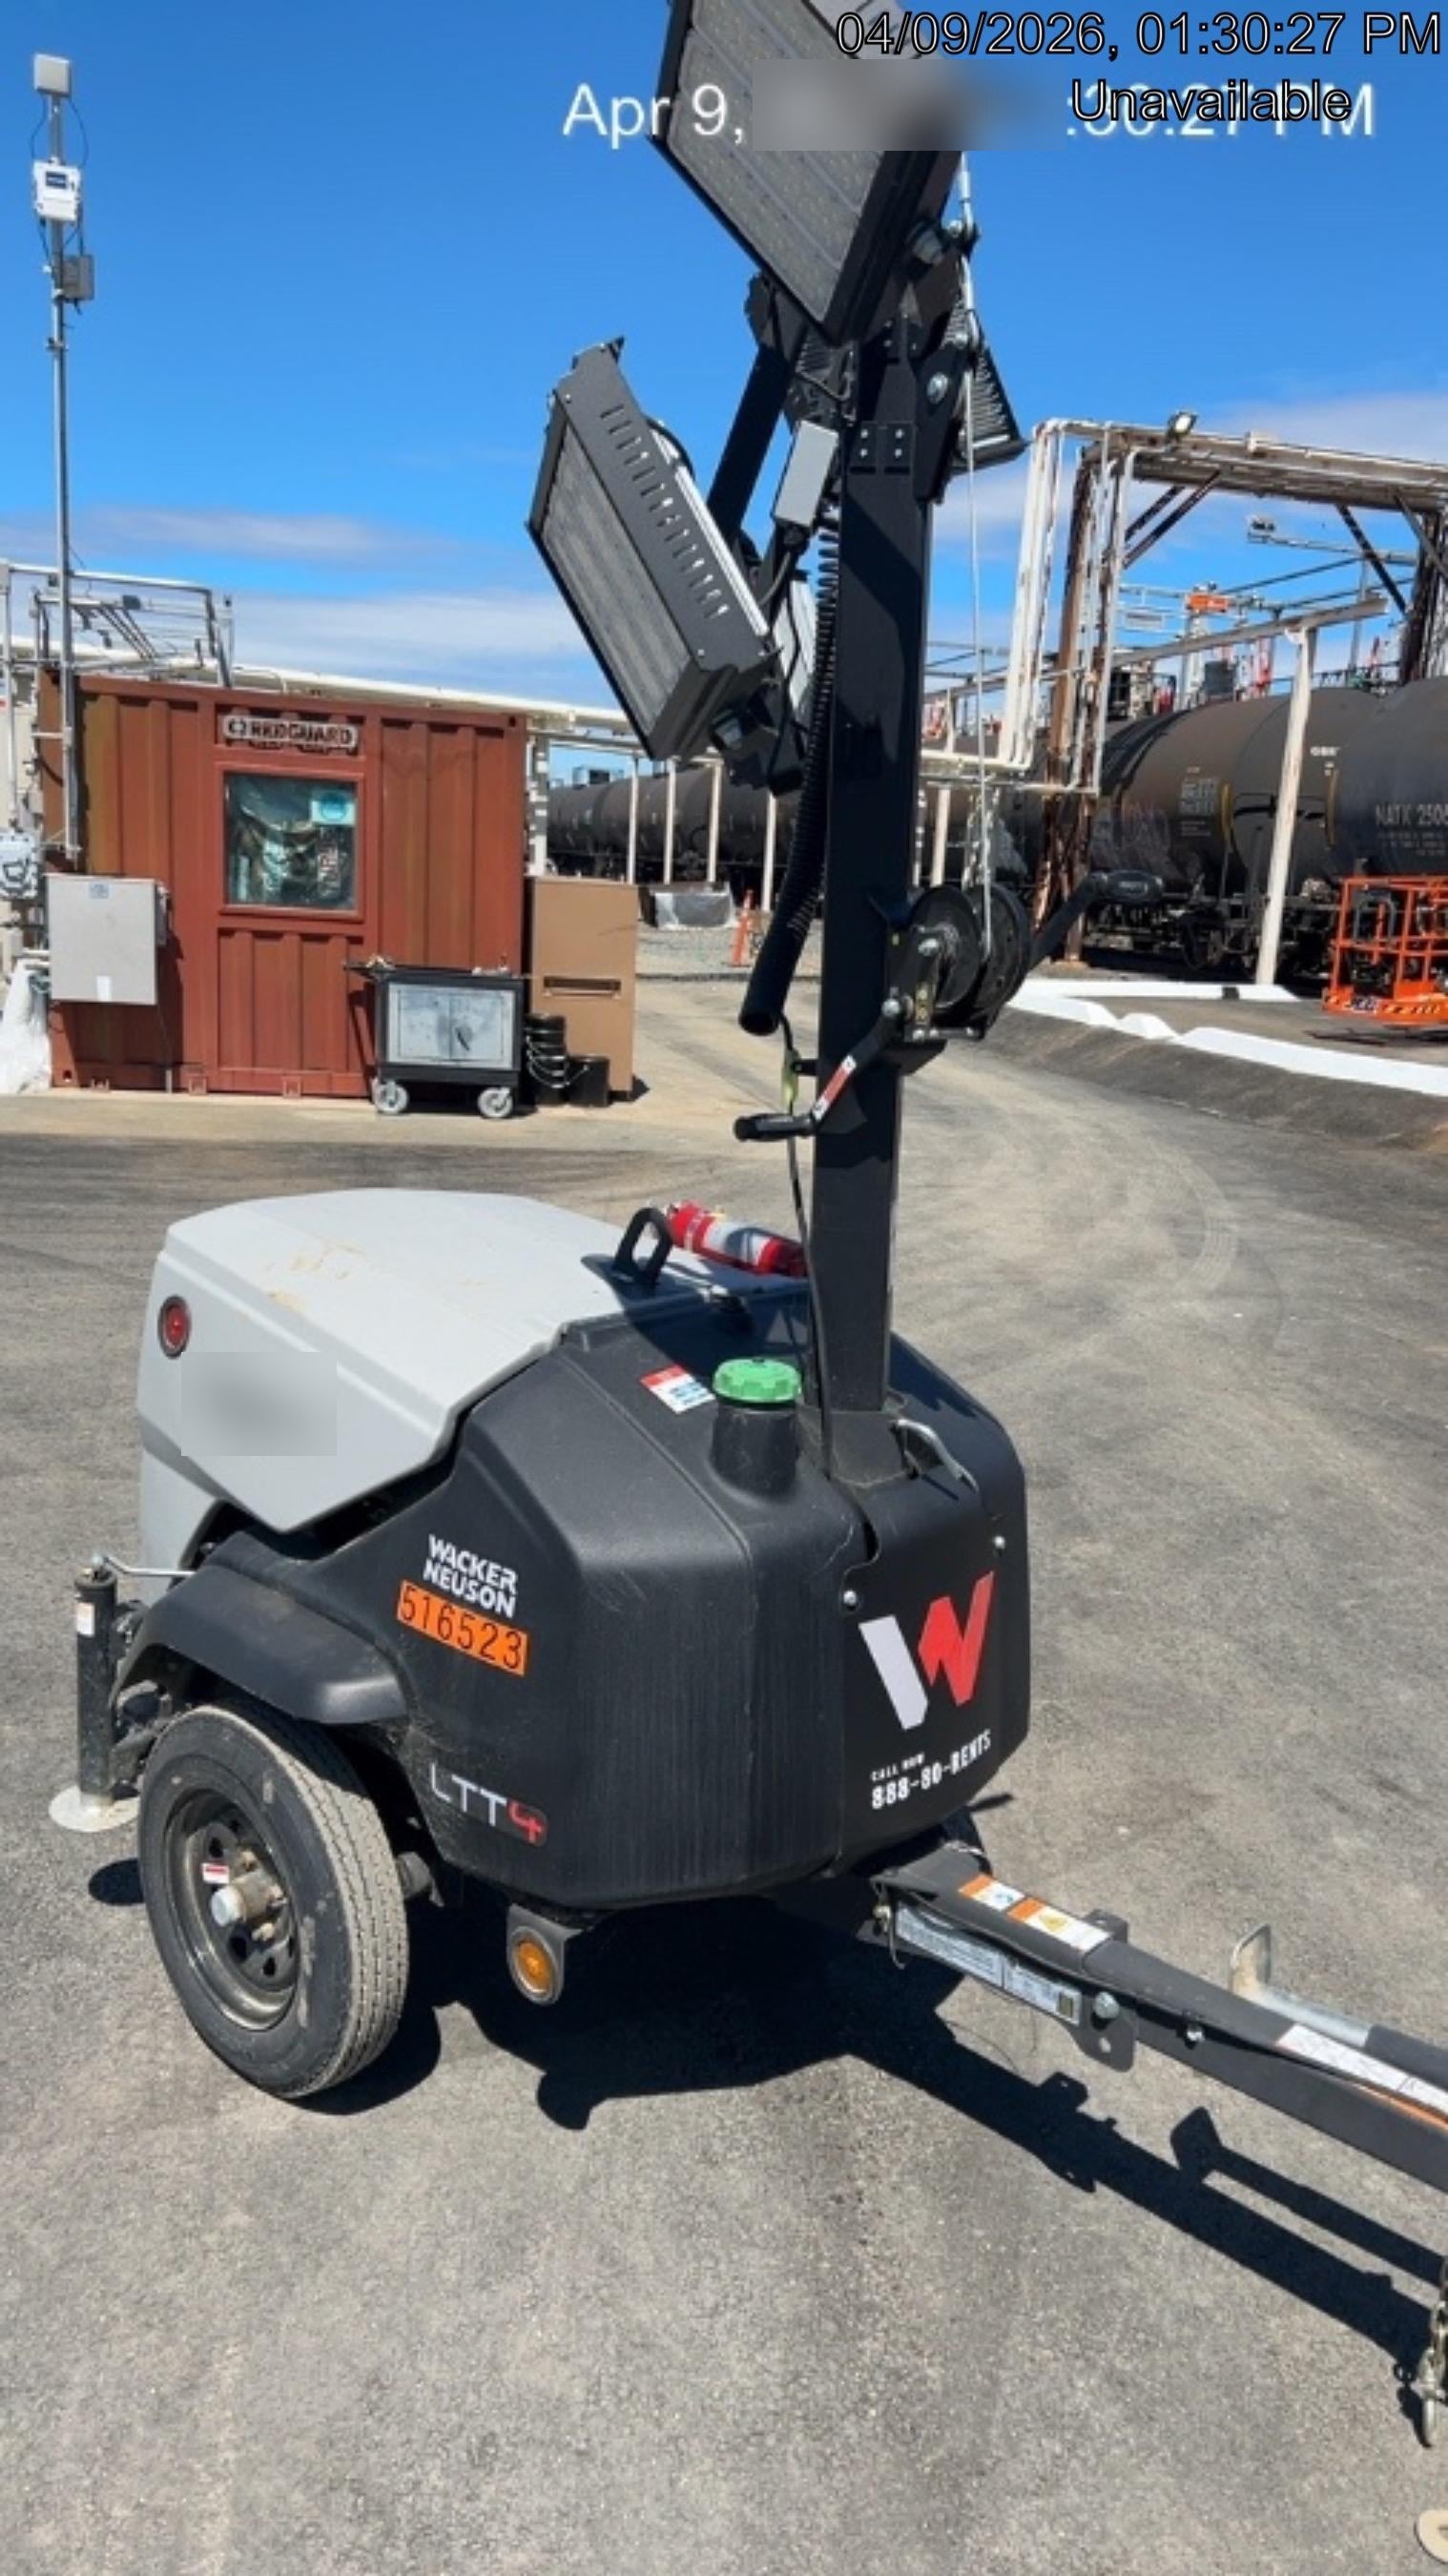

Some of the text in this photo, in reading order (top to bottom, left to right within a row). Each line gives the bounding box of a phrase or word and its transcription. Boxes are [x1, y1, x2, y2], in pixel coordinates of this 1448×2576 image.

[423, 1559, 516, 1618] NEUSON
[429, 1533, 518, 1596] WACKER
[401, 1585, 522, 1669] 516523
[431, 1762, 544, 1843] LTT4
[872, 1728, 992, 1811] 888-80-RENTS
